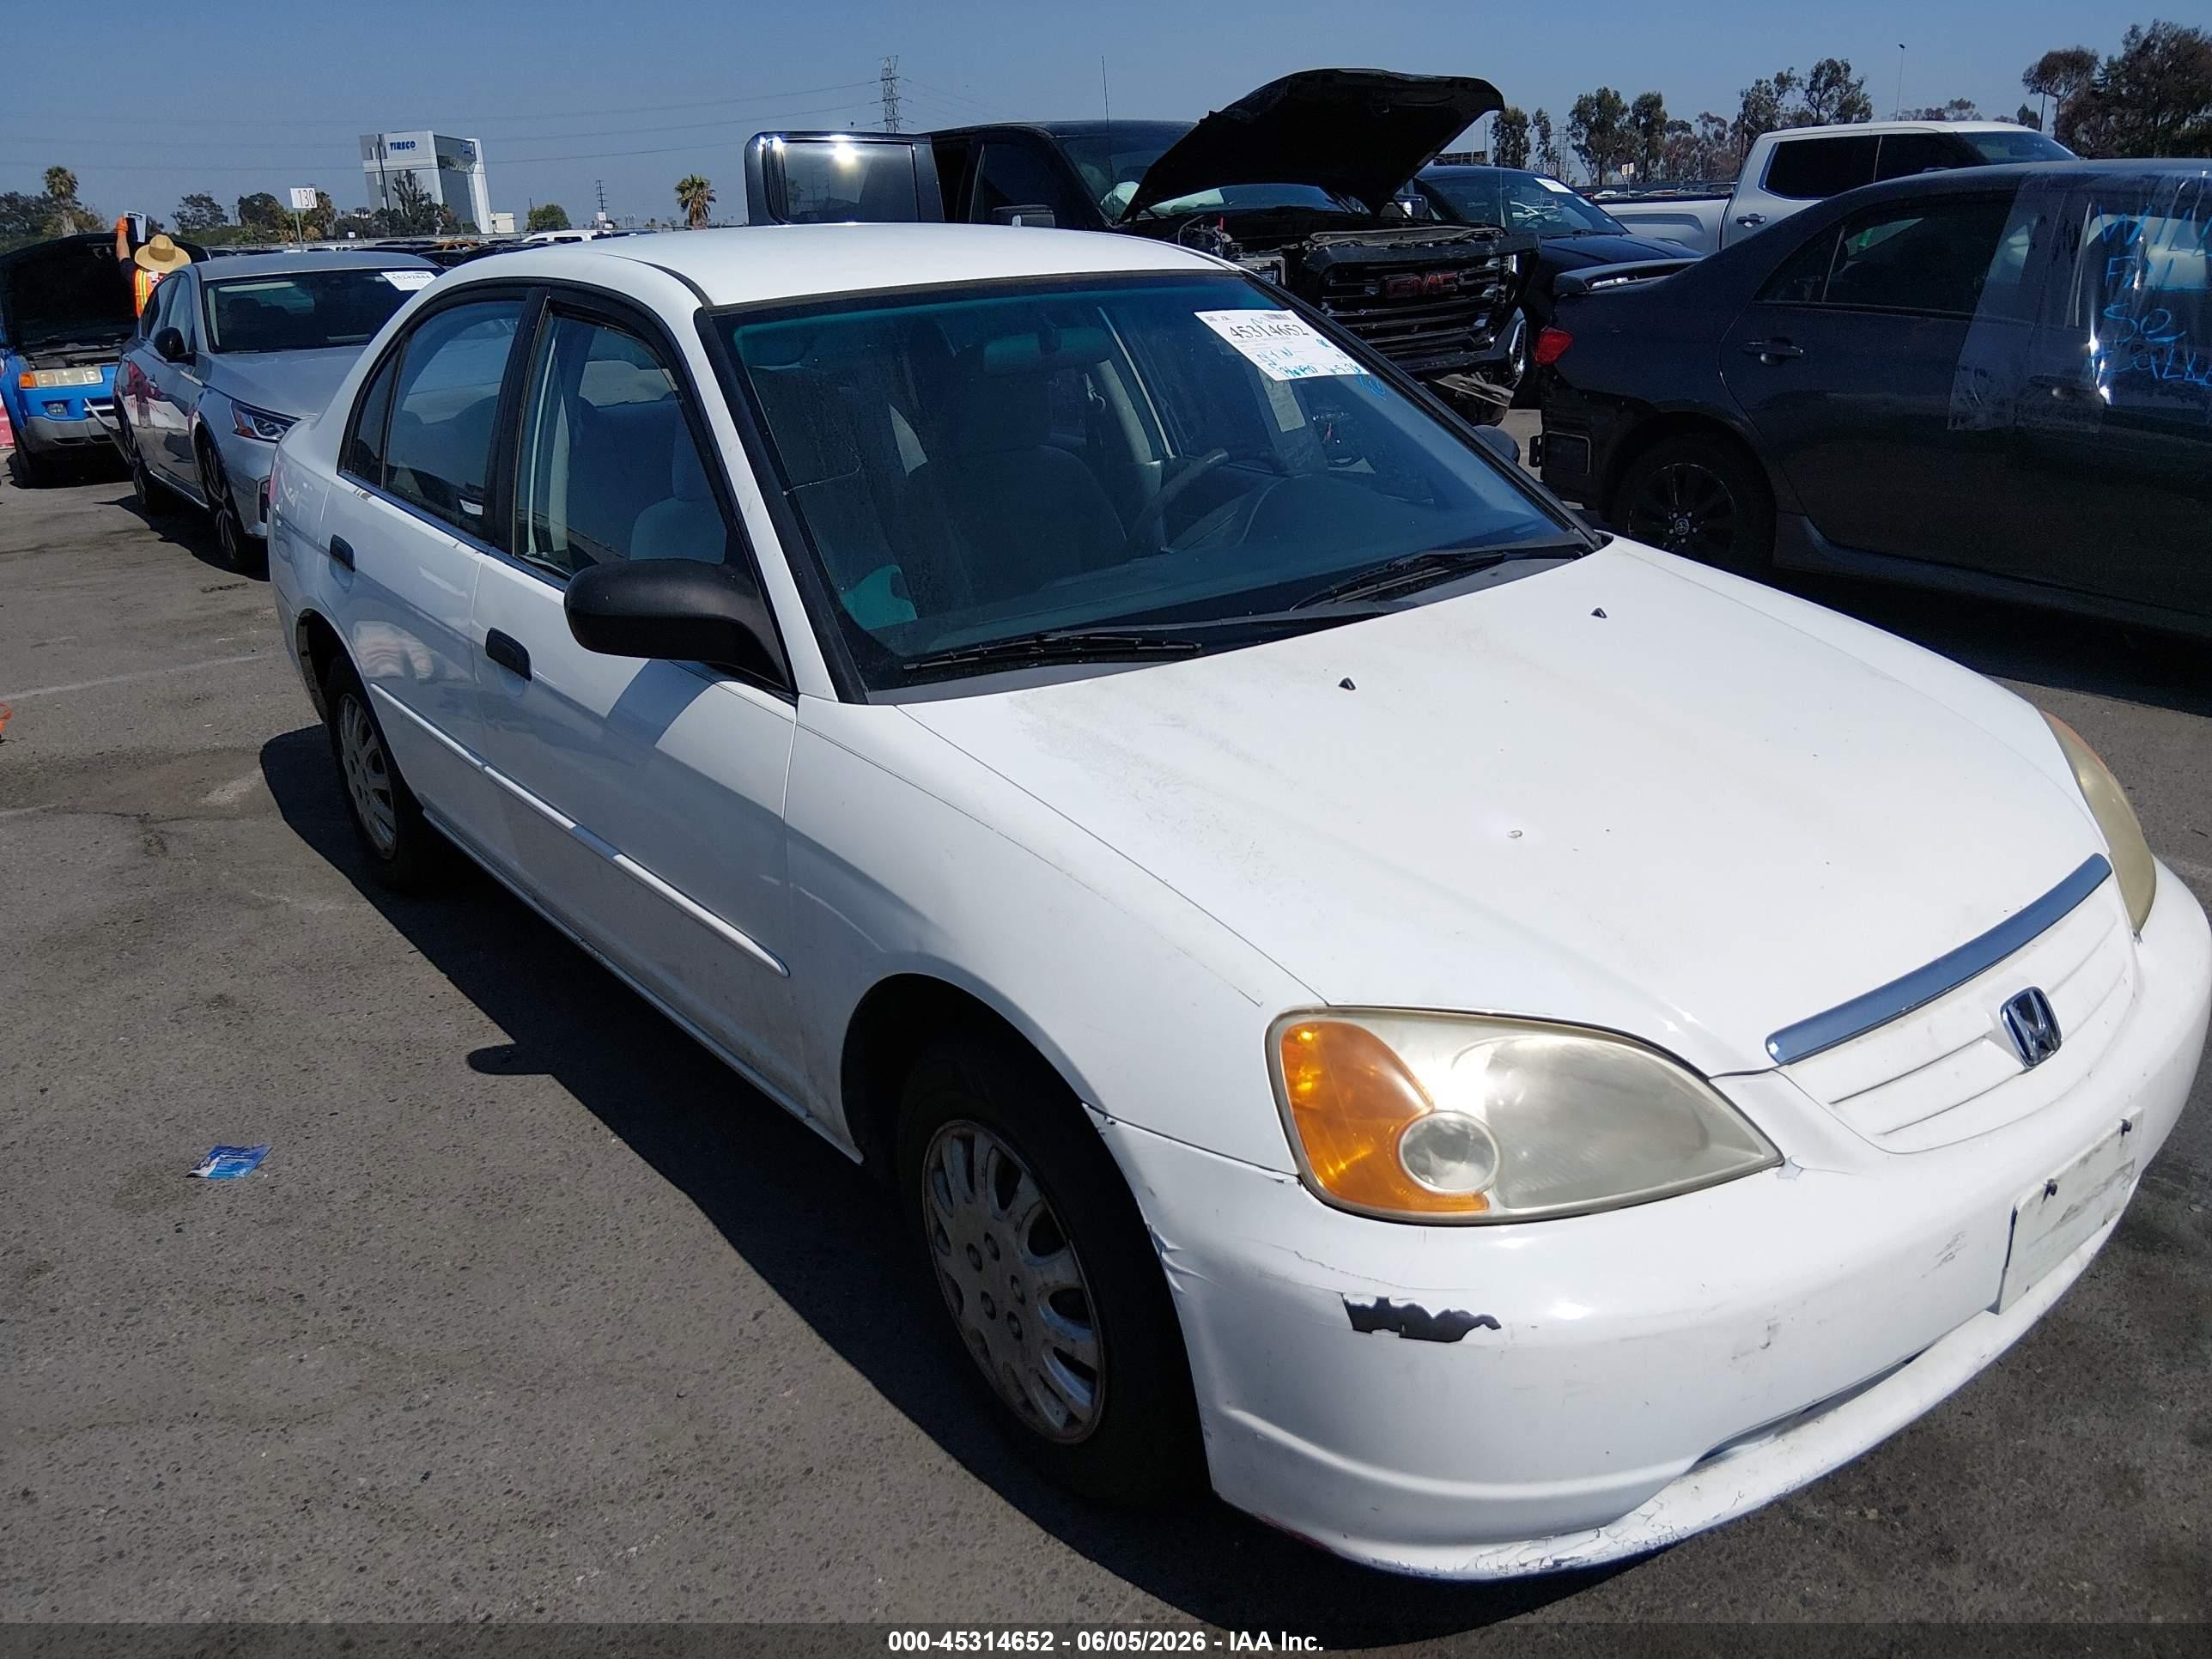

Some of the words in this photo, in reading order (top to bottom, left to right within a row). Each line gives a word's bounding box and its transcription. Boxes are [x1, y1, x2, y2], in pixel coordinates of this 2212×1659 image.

[390, 141, 416, 151] TIRECO
[298, 189, 316, 207] 130
[1387, 270, 1457, 299] GMC
[1230, 324, 1310, 339] 45314652
